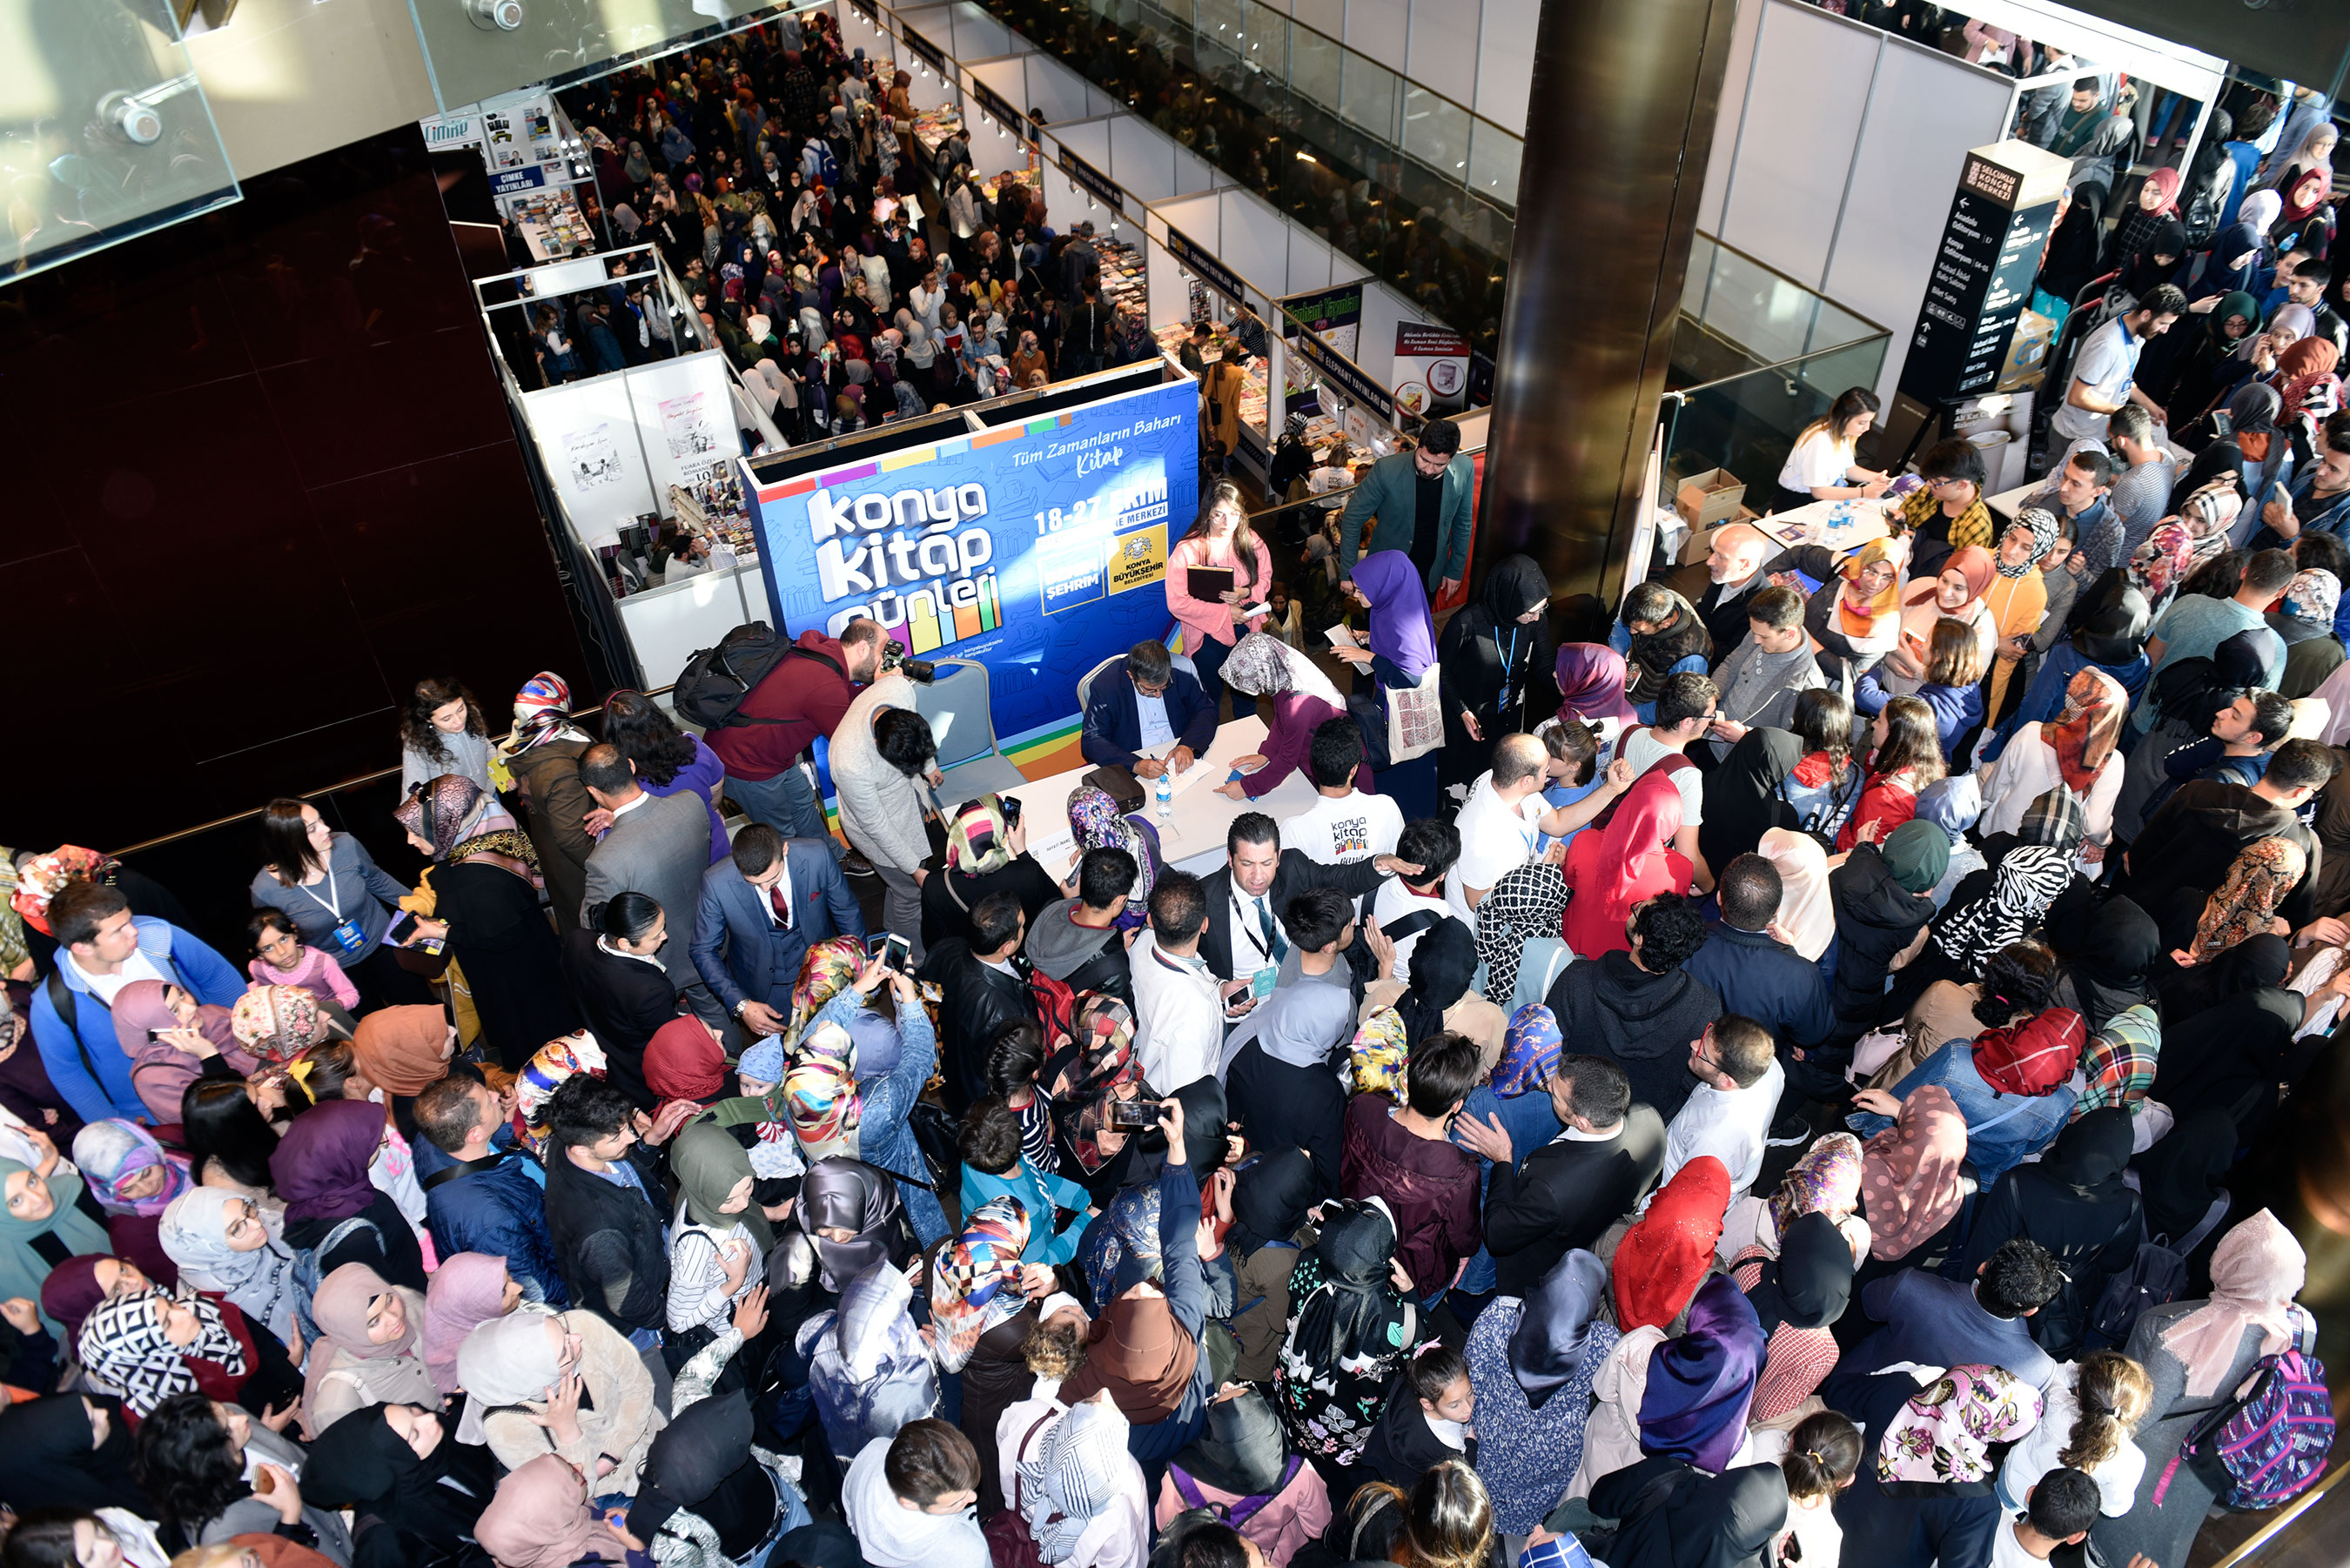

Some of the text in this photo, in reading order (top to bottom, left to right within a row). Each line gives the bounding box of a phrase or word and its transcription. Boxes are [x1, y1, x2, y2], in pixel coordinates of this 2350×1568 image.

[495, 179, 534, 194] YAYINLARI
[1978, 173, 2014, 193] KONGRE
[1954, 211, 1978, 227] Anadolu
[1951, 220, 1981, 239] Oditoryum
[1946, 237, 1964, 250] Konya
[1944, 245, 1972, 265] Oditoryum
[1931, 285, 1944, 298] Bilet
[1949, 276, 1967, 291] Salonu
[1325, 356, 1352, 384] ELEPHANT
[1352, 376, 1380, 406] YAYINLARI
[1013, 414, 1182, 467] Tüm Zamanların Baharı
[1077, 446, 1124, 479] Kitap
[809, 483, 988, 542] konya
[1034, 477, 1167, 535] 18-27 EKİM
[1127, 505, 1166, 525] MERKEZİ
[816, 527, 992, 602] kitap
[1113, 562, 1164, 583] BÜYÜKŞEHİR
[1125, 559, 1151, 571] KONYA
[1124, 573, 1154, 586] BELEDİYESİ
[1331, 816, 1366, 832] konya
[1333, 828, 1367, 842] kitap
